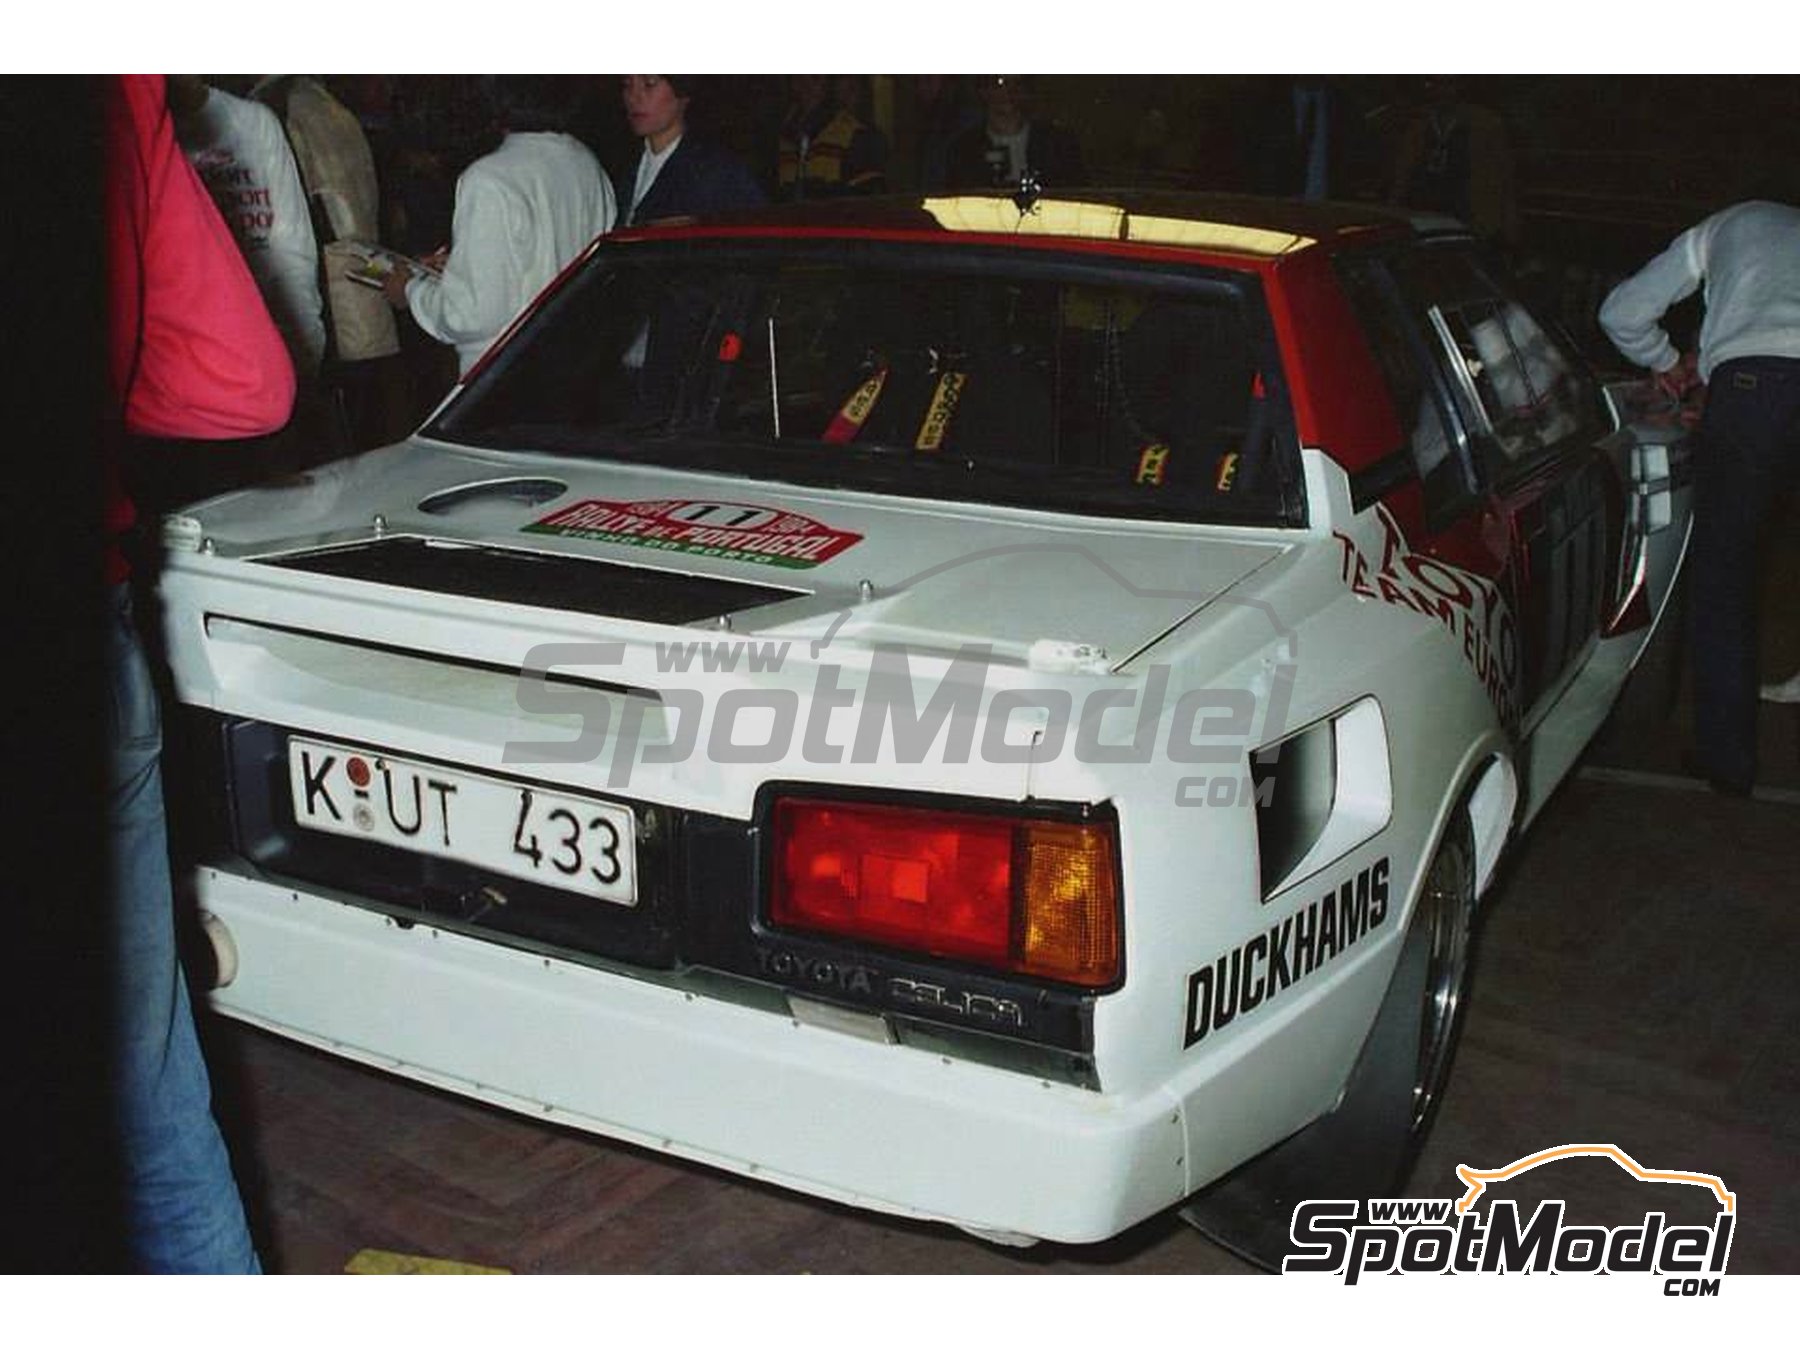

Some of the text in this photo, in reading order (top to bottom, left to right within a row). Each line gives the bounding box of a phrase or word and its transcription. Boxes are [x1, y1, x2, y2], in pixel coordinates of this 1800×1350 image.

[685, 505, 762, 527] 11
[560, 529, 774, 563] VINHO DO PORTO
[671, 526, 841, 560] PORTUGAL
[1333, 530, 1456, 636] TEAM
[513, 788, 622, 884] 433
[756, 946, 872, 993] TOYOTA
[1183, 857, 1390, 1050] DUCKHAMS
